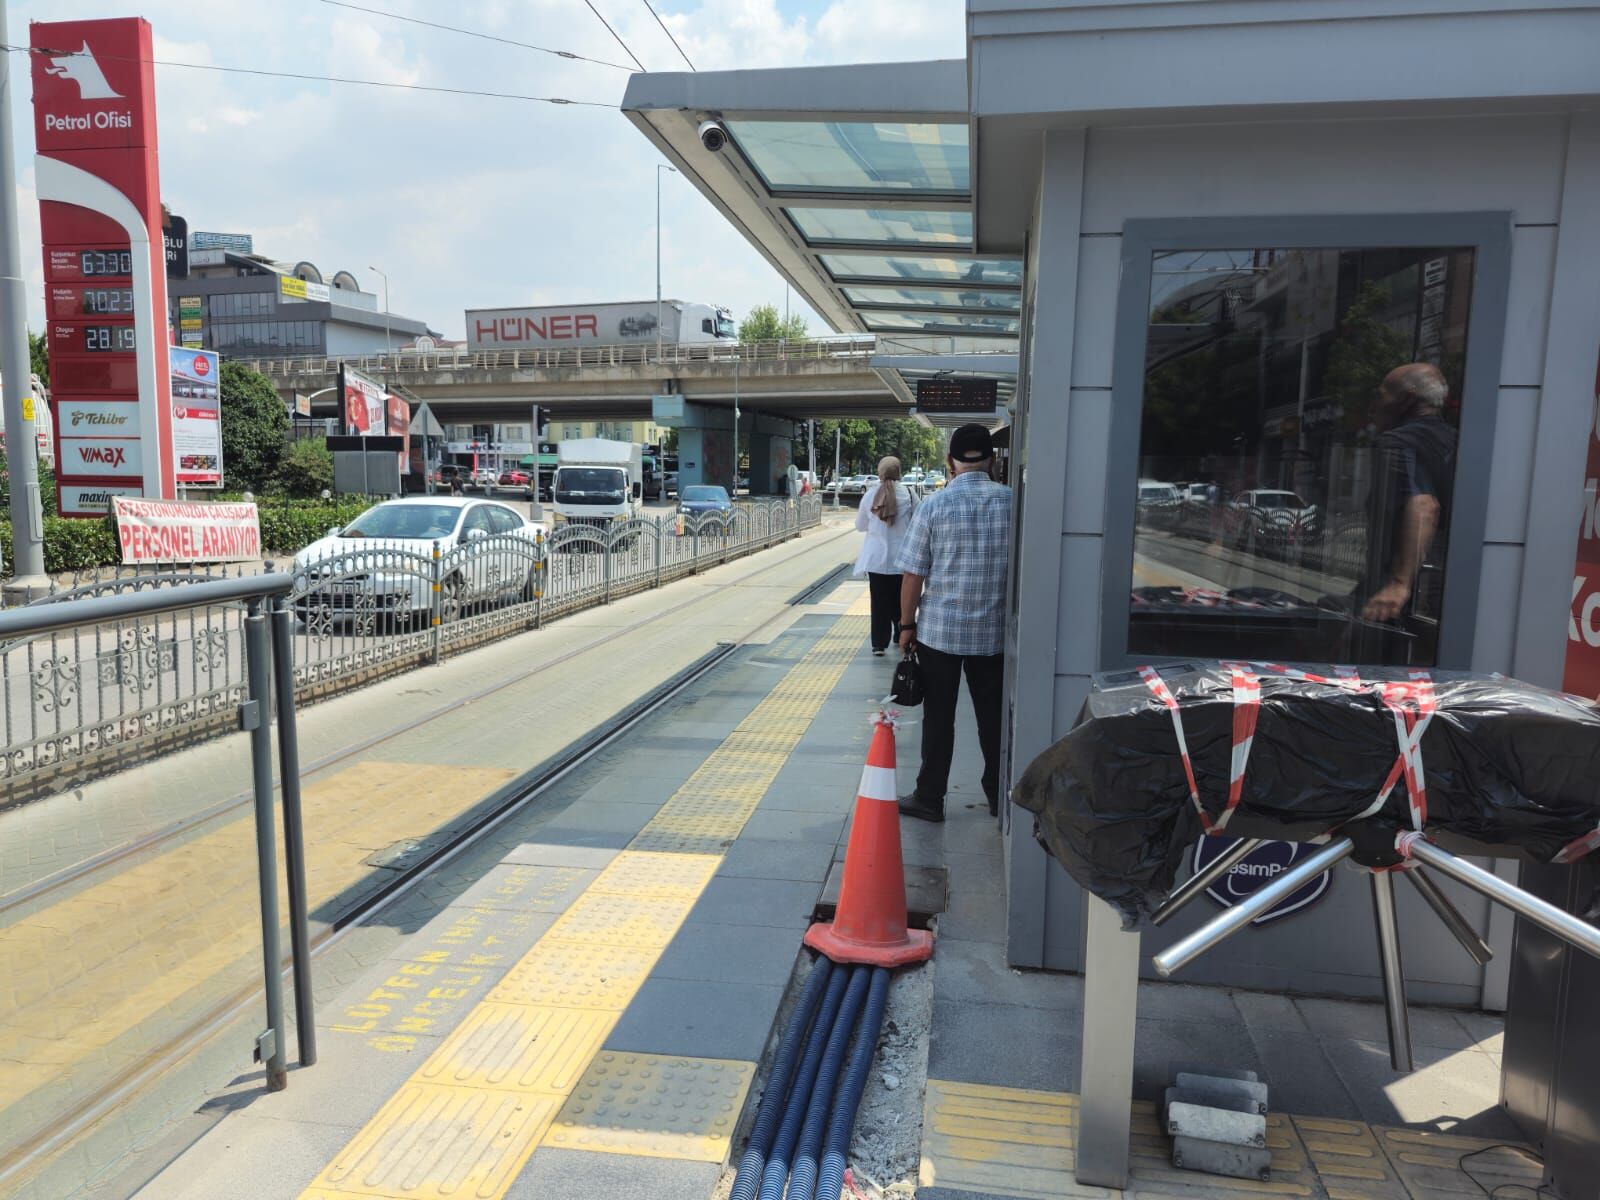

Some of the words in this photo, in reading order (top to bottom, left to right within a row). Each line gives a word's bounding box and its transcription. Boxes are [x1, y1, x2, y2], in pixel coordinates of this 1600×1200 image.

[45, 113, 91, 131] Petrol
[94, 110, 132, 129] Ofisi
[476, 314, 599, 342] HÜNER
[85, 412, 128, 425] Tchibo
[120, 524, 200, 559] PERSONEL
[202, 525, 260, 557] ARANIYOR
